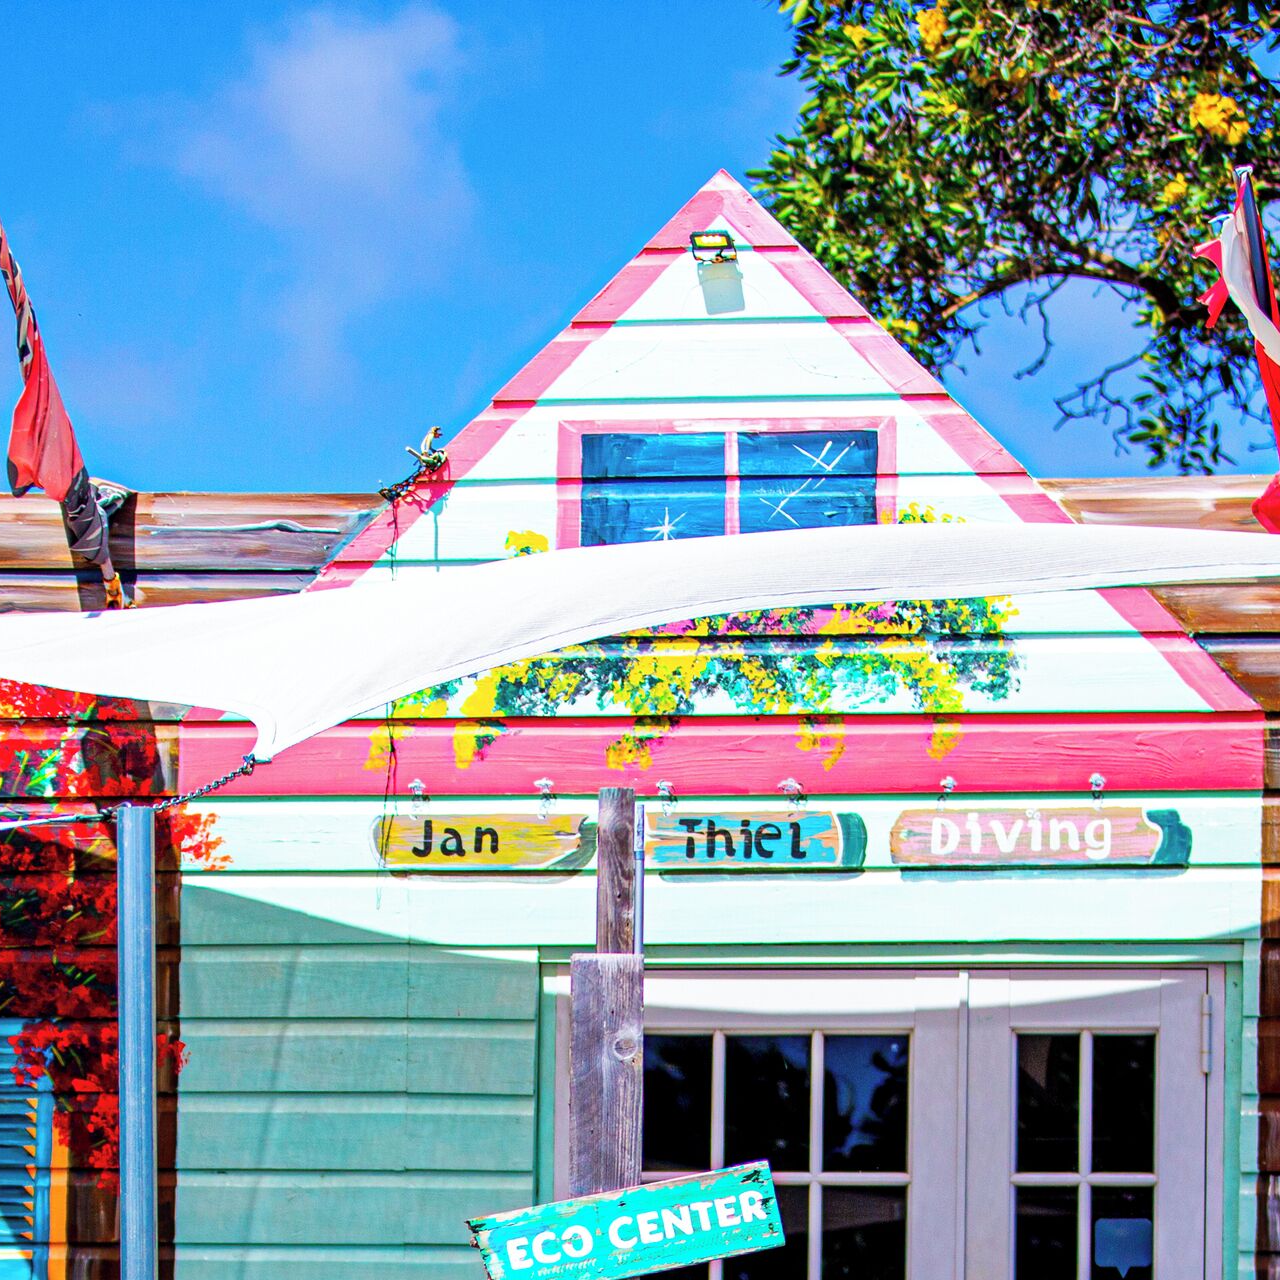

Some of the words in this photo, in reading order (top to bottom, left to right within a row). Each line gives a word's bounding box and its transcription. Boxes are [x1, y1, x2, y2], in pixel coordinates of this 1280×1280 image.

[412, 818, 501, 858] Jan
[677, 816, 807, 860] Thiel
[930, 808, 1112, 858] Diving
[506, 1225, 594, 1272] ECO
[608, 1190, 767, 1250] CENTER
